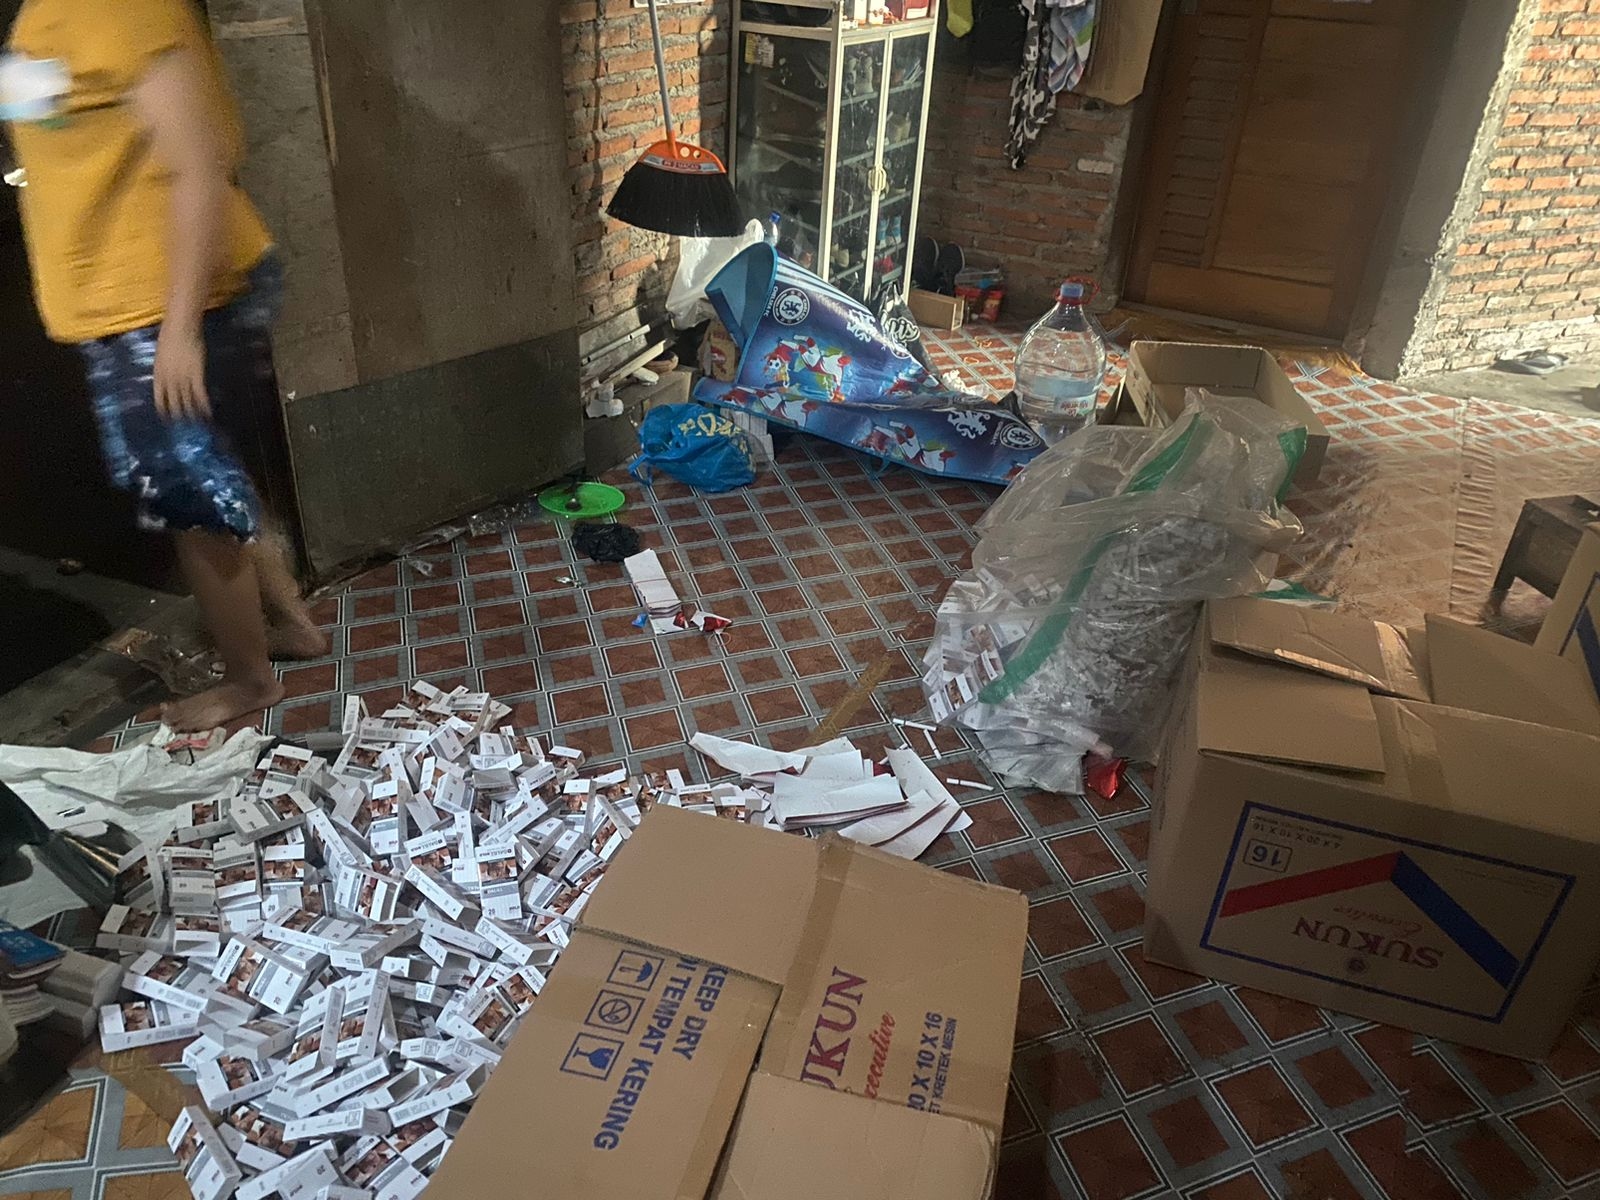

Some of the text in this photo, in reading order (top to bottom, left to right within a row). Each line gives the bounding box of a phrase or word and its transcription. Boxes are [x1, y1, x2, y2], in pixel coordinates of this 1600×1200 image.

[1252, 844, 1283, 867] 16
[1292, 916, 1444, 970] SUKUN
[637, 975, 692, 1056] TEMPAT
[671, 965, 729, 1061] KEEP DRY
[923, 1010, 943, 1029] 16
[919, 1033, 940, 1049] X
[939, 1017, 958, 1050] MESIN
[915, 1050, 937, 1072] 10
[930, 1050, 953, 1100] KRETEK
[911, 1073, 932, 1092] X
[593, 1056, 654, 1151] KERING
